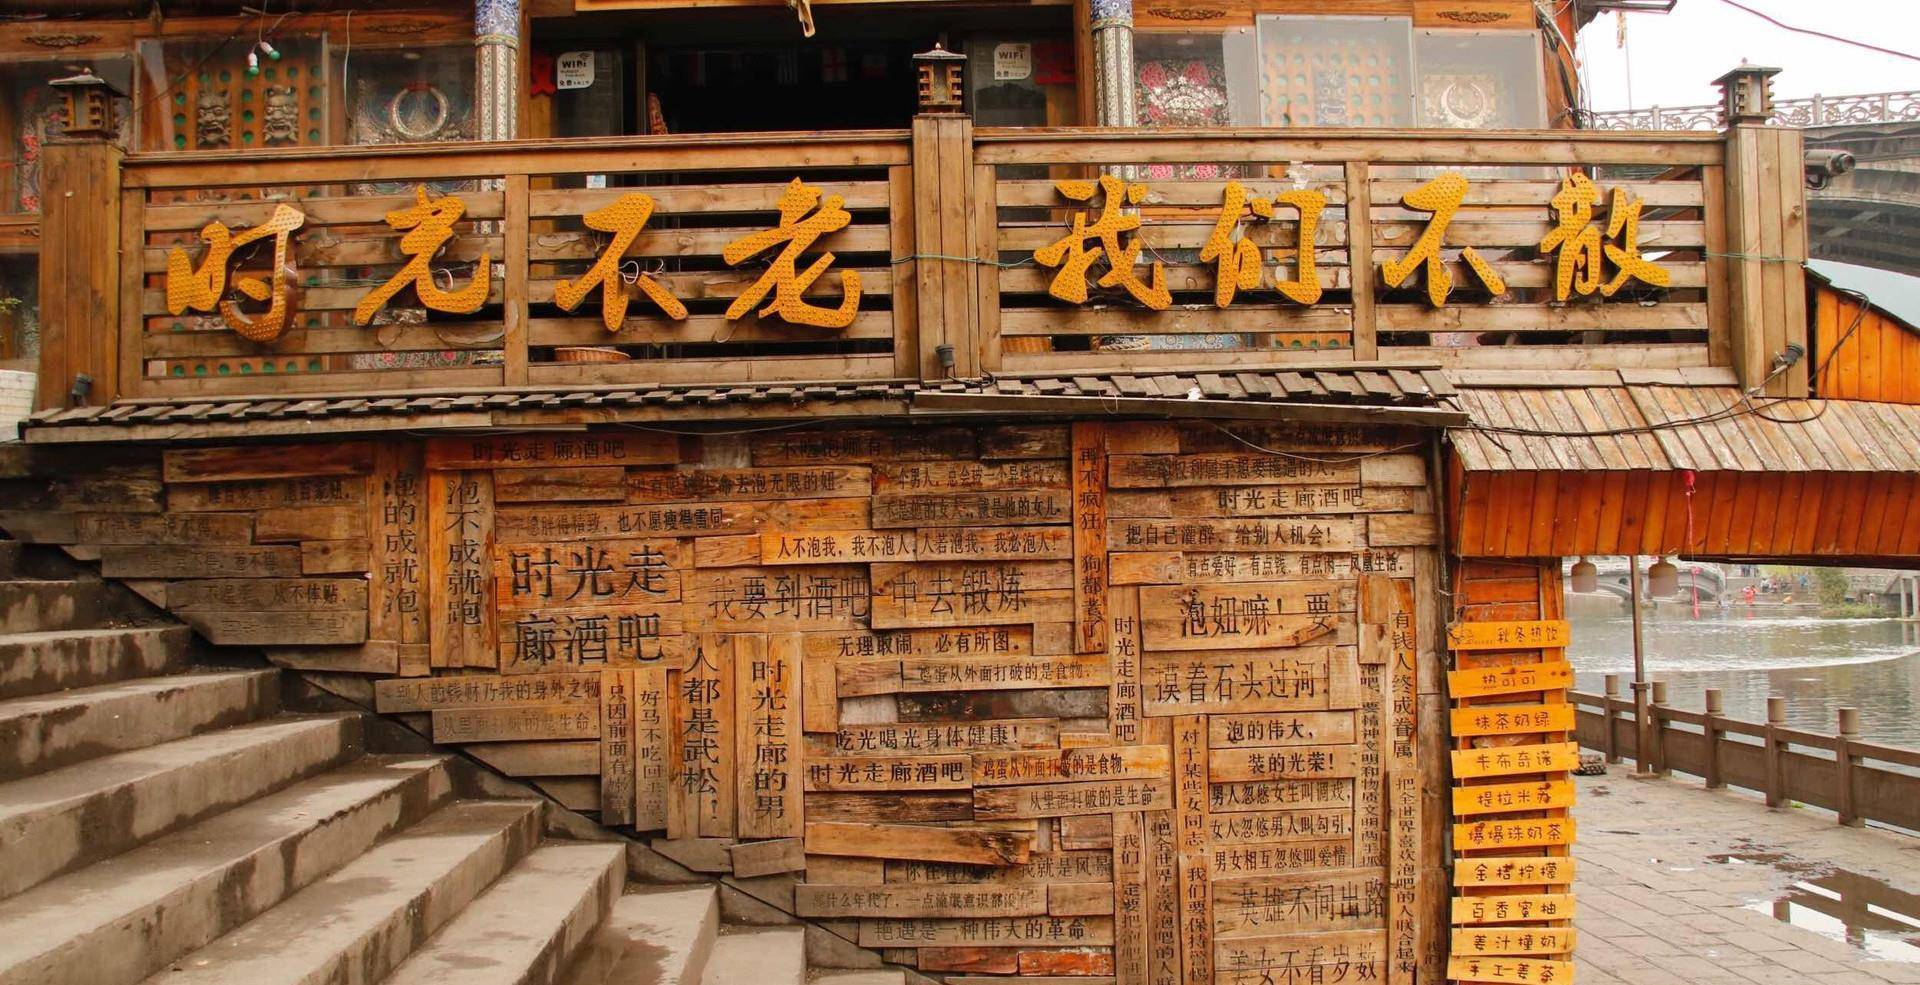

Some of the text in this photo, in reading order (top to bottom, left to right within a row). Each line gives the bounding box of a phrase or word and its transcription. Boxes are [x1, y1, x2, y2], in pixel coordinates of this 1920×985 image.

[166, 172, 1670, 343] 时光不老 我们不散
[472, 439, 626, 461] 时光走廊酒吧
[1218, 487, 1365, 510] 时光走廊酒吧
[510, 545, 669, 600] 时光走
[512, 612, 664, 666] 廊酒吧
[1114, 617, 1136, 742] 时光走廊酒吧
[1475, 711, 1550, 730] 抹茶奶绿
[752, 659, 788, 819] 时光走廊的男
[1477, 751, 1552, 770] 卡布奇诺
[810, 762, 964, 784] 时光走廊酒吧
[1475, 862, 1557, 881] 金桔柠檬
[1236, 877, 1385, 926] 英雄不问出路
[1472, 901, 1556, 919] 百香蜜柚
[1473, 934, 1556, 951] 姜汁撞奶
